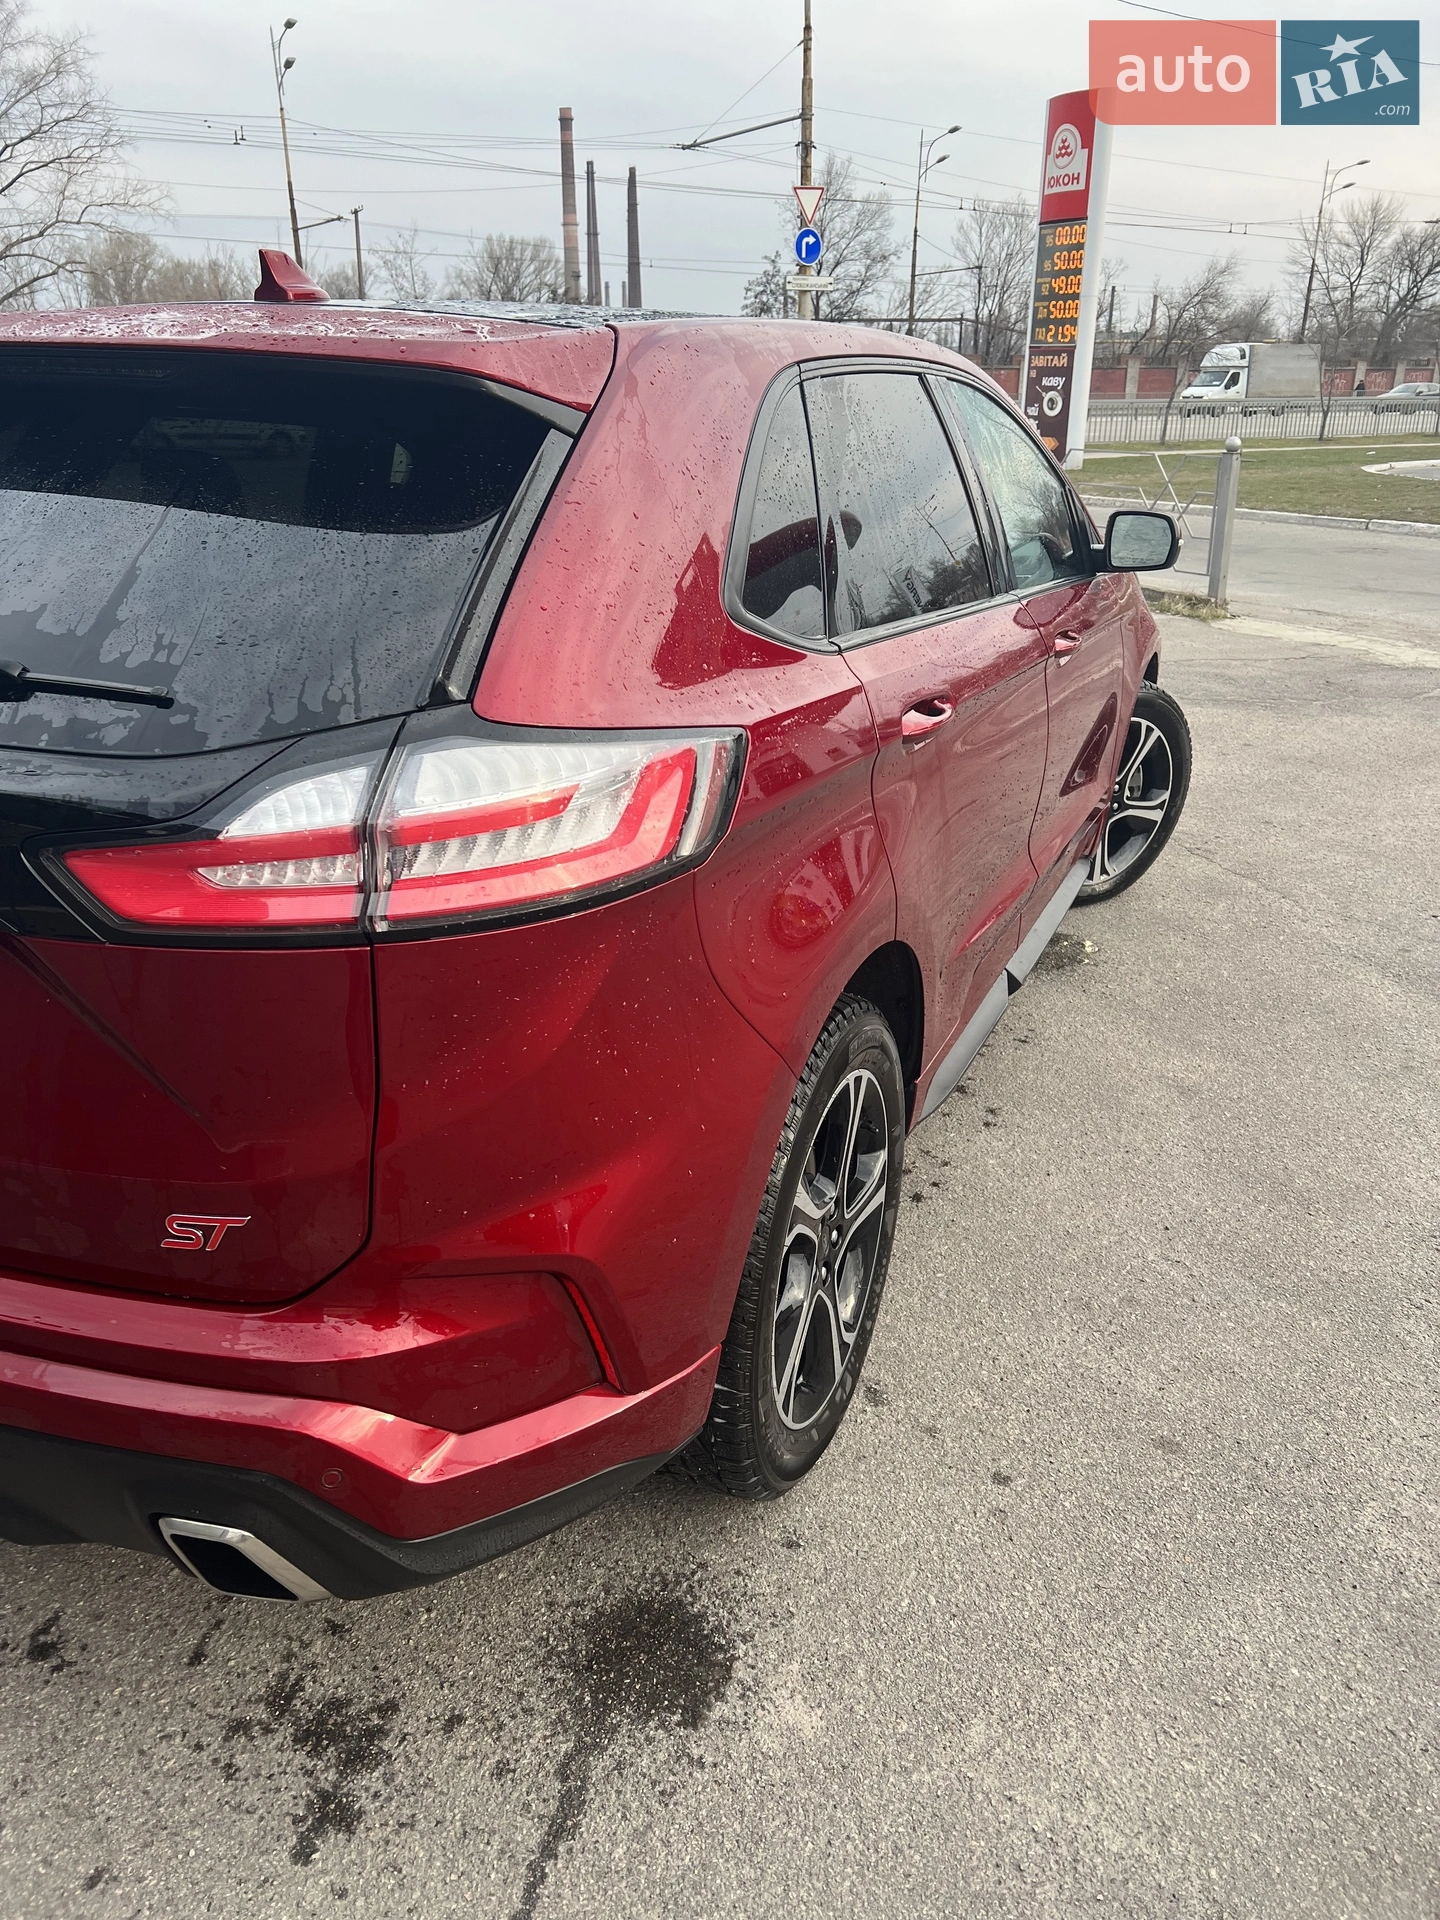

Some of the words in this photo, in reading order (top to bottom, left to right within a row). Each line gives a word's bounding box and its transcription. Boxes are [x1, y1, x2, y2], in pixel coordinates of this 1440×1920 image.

[1047, 172, 1081, 190] ЮКОН
[1046, 235, 1054, 247] 95
[1055, 224, 1087, 246] 00.00
[1044, 259, 1052, 271] 95
[1053, 250, 1085, 270] 50.00
[1051, 275, 1082, 294] 49.00
[1049, 299, 1080, 319] 50.00
[1046, 324, 1078, 343] 21.94
[1030, 352, 1068, 367] ЗАВІТАЙ
[1041, 376, 1066, 390] каву
[160, 1213, 252, 1251] ST
